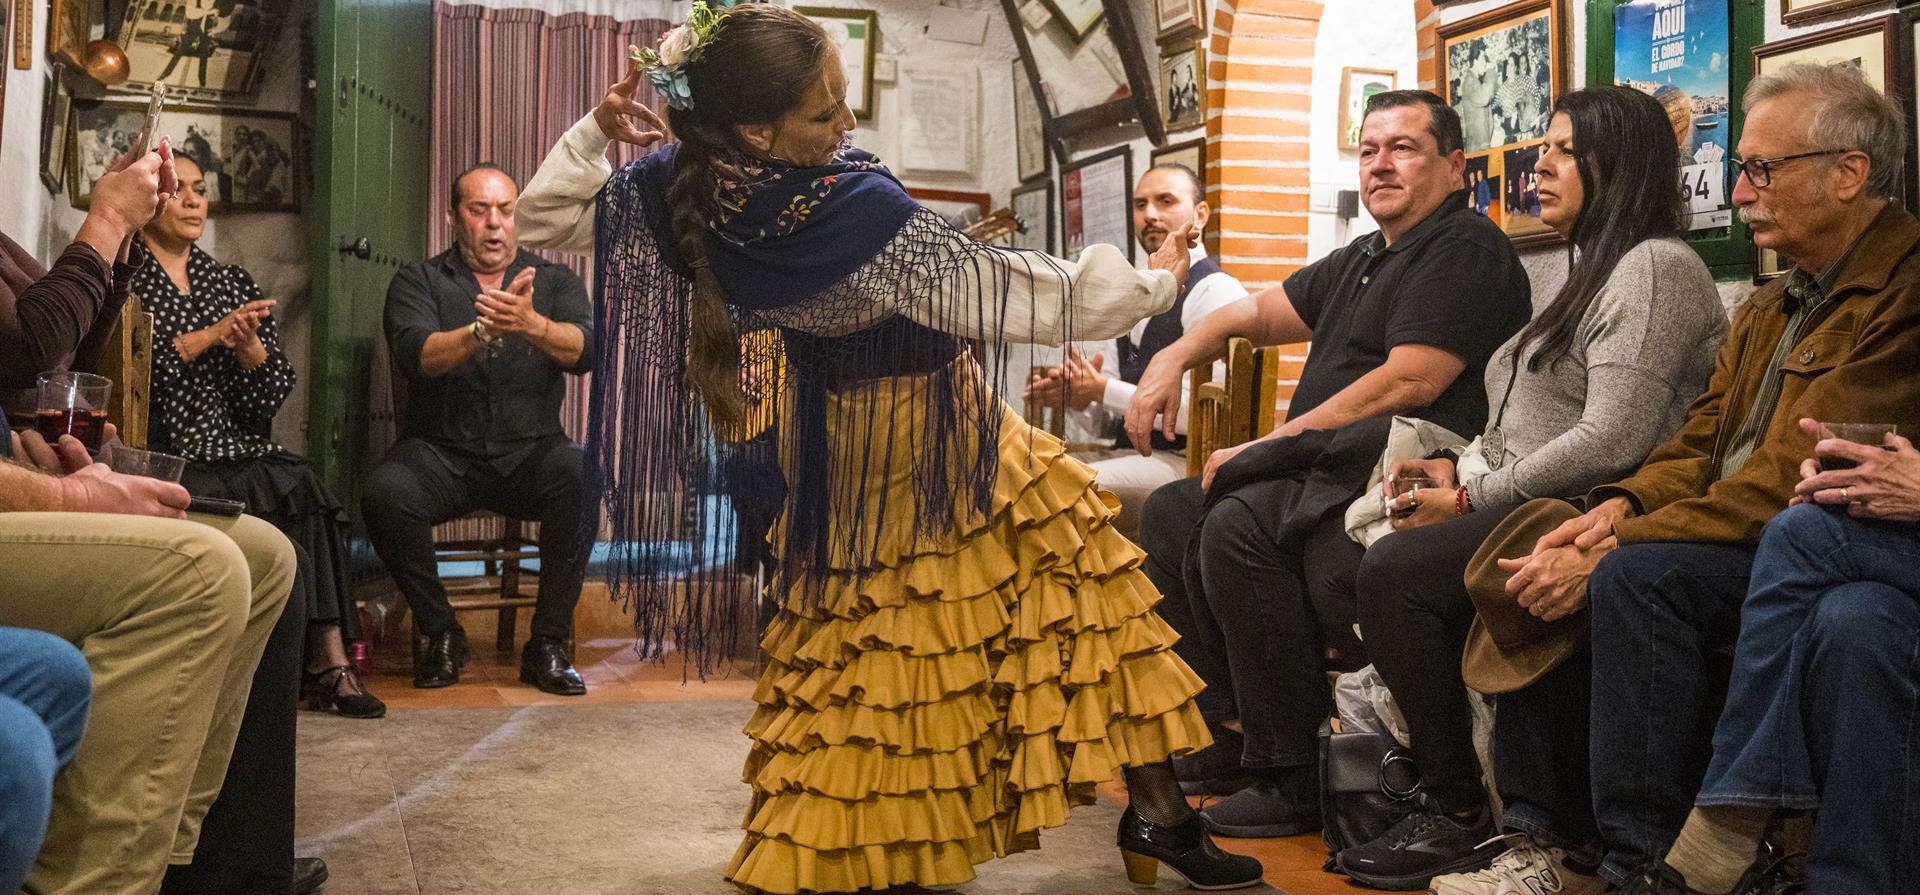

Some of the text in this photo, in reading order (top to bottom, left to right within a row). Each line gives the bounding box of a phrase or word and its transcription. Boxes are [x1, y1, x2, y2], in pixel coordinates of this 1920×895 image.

[1651, 40, 1685, 62] EL GORDO
[1651, 62, 1659, 74] DE
